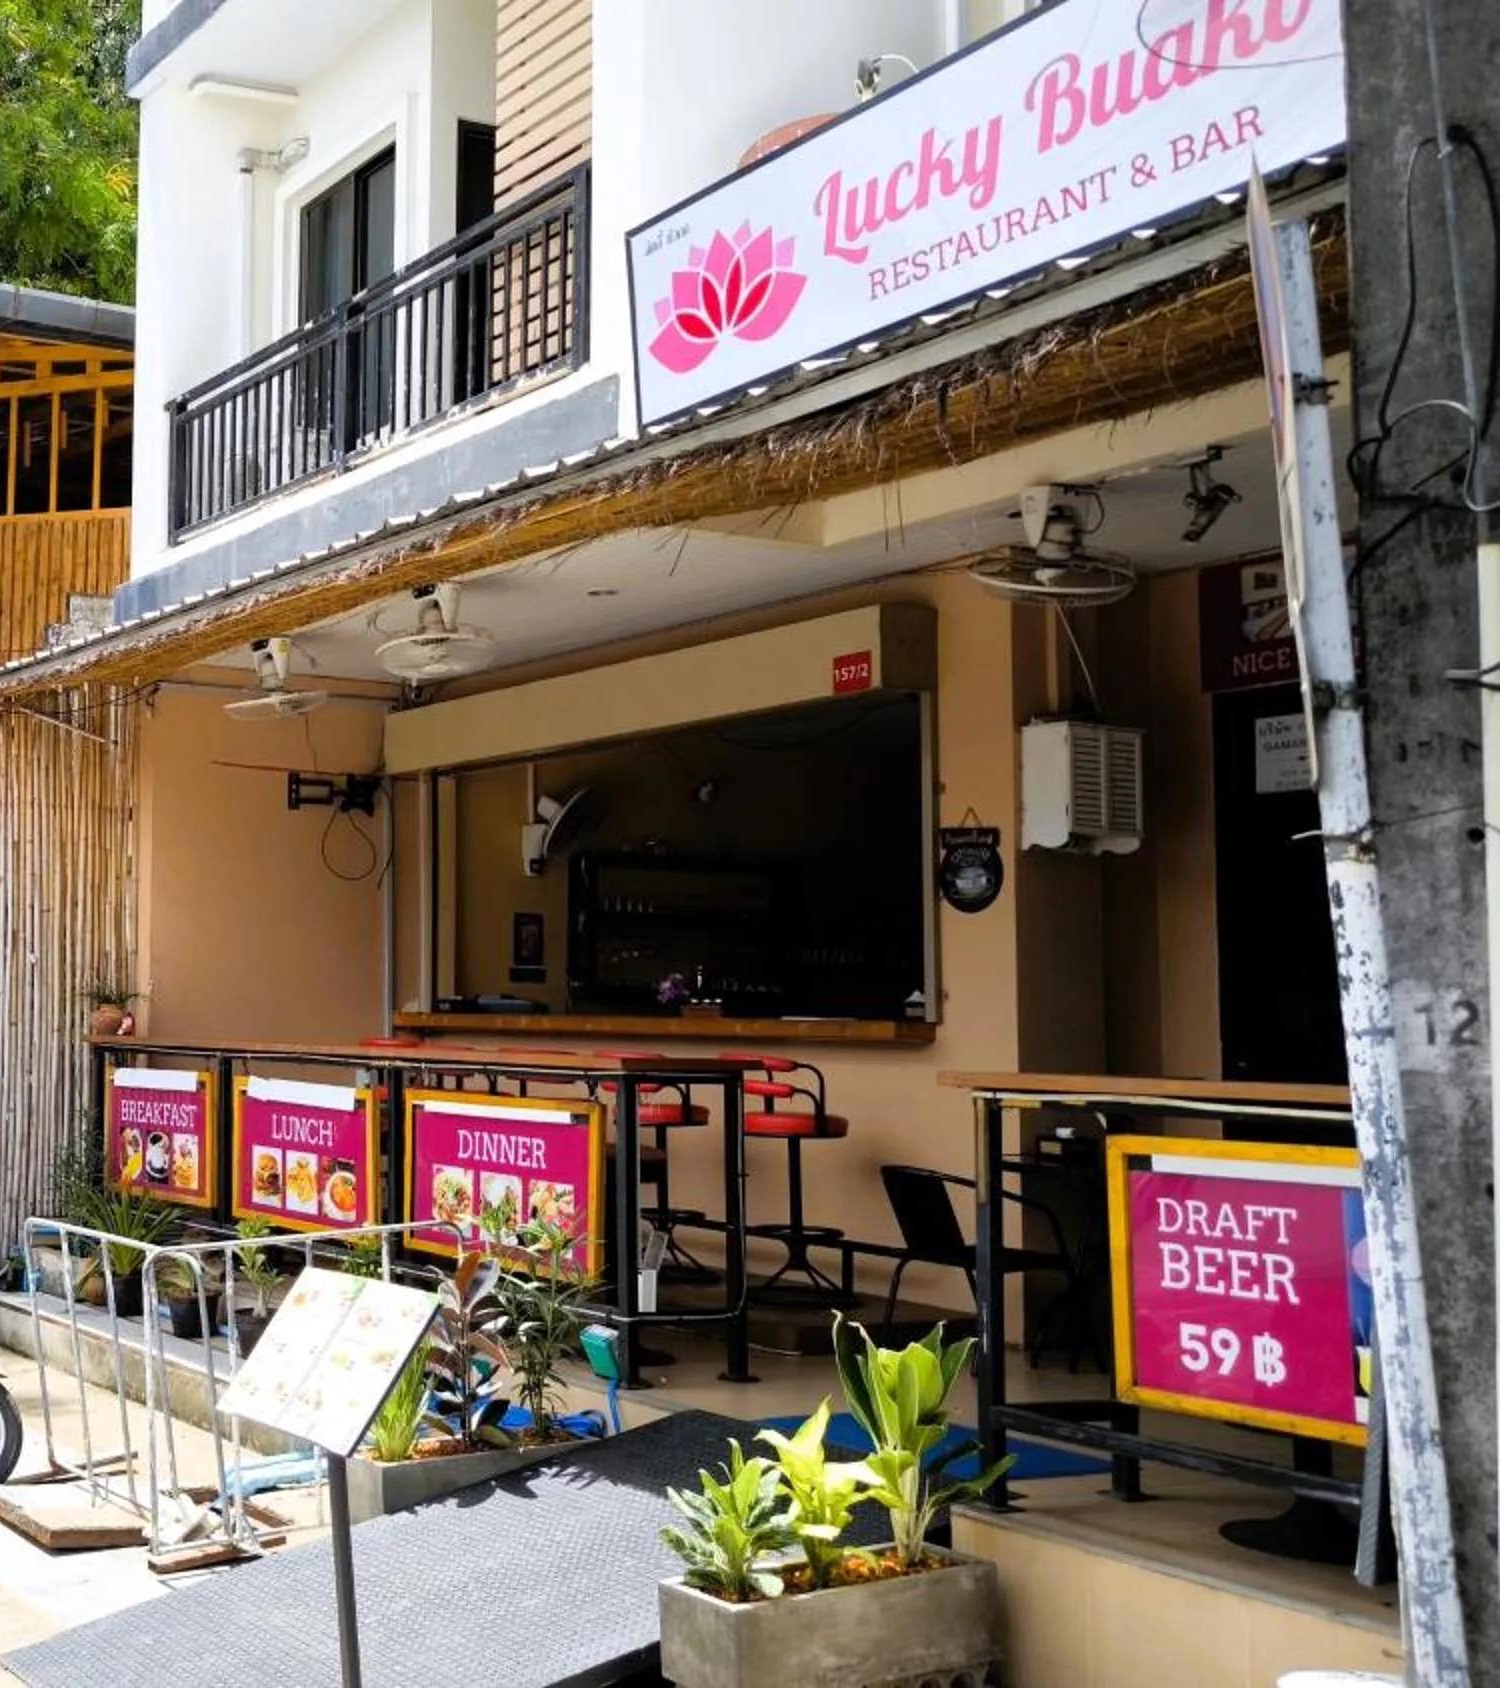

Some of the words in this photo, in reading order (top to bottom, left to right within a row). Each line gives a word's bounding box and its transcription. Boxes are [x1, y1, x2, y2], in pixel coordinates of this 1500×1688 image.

[812, 115, 1002, 265] Lucky
[867, 166, 1117, 301] RESTAURANT
[1130, 153, 1157, 189] &
[1168, 105, 1265, 174] BAR
[835, 663, 869, 683] 157/2
[120, 1098, 198, 1130] BREAKFAST
[271, 1113, 334, 1149] LUNCH
[457, 1129, 546, 1170] DINNER
[1156, 1197, 1298, 1245] DRAFT
[1158, 1241, 1301, 1305] BEER
[1179, 1322, 1241, 1377] 59
